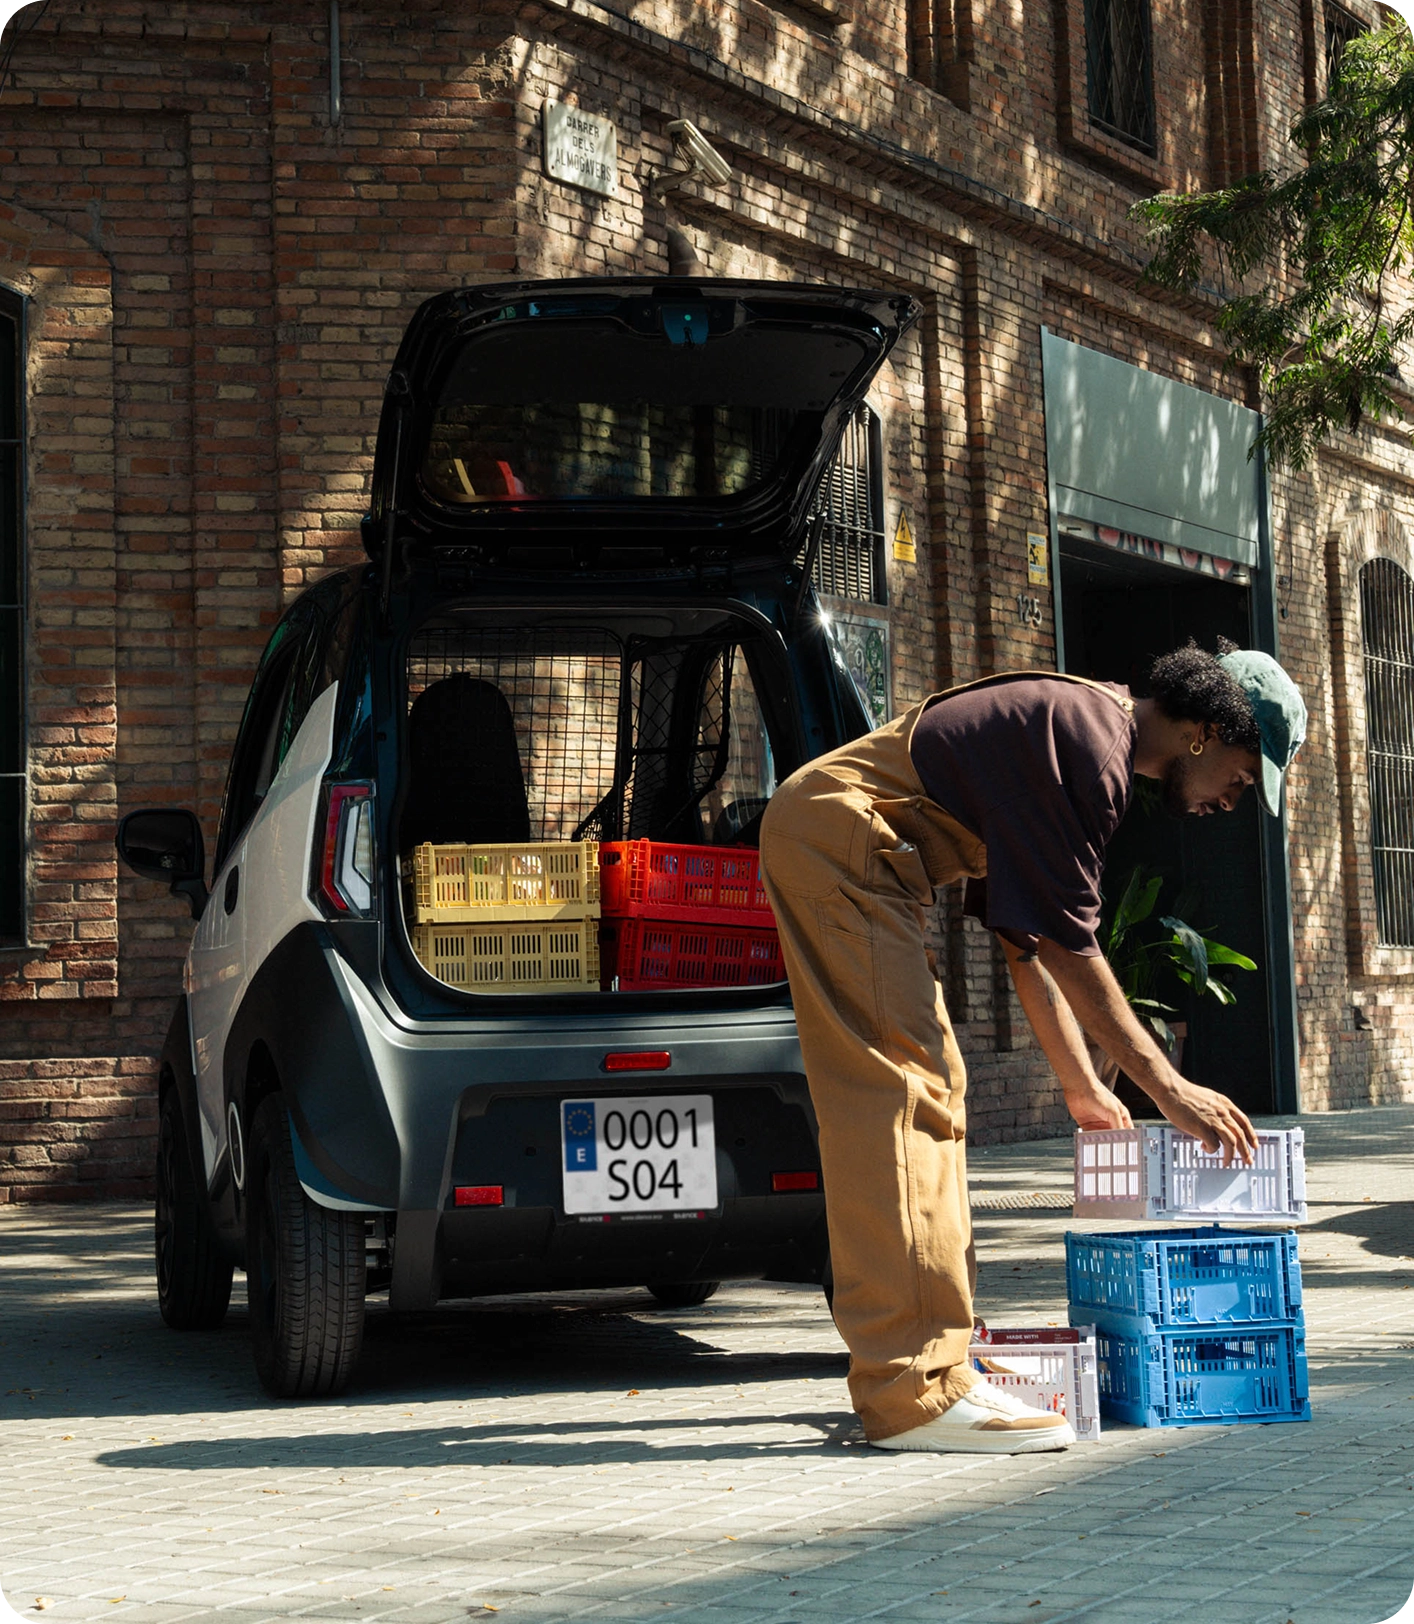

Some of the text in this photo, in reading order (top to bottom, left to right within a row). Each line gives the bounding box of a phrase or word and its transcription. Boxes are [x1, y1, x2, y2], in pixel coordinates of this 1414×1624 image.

[566, 115, 599, 138] CARRER
[572, 136, 595, 153] DELS
[1017, 594, 1042, 625] 125
[603, 1108, 698, 1151] 0001
[577, 1148, 586, 1162] E
